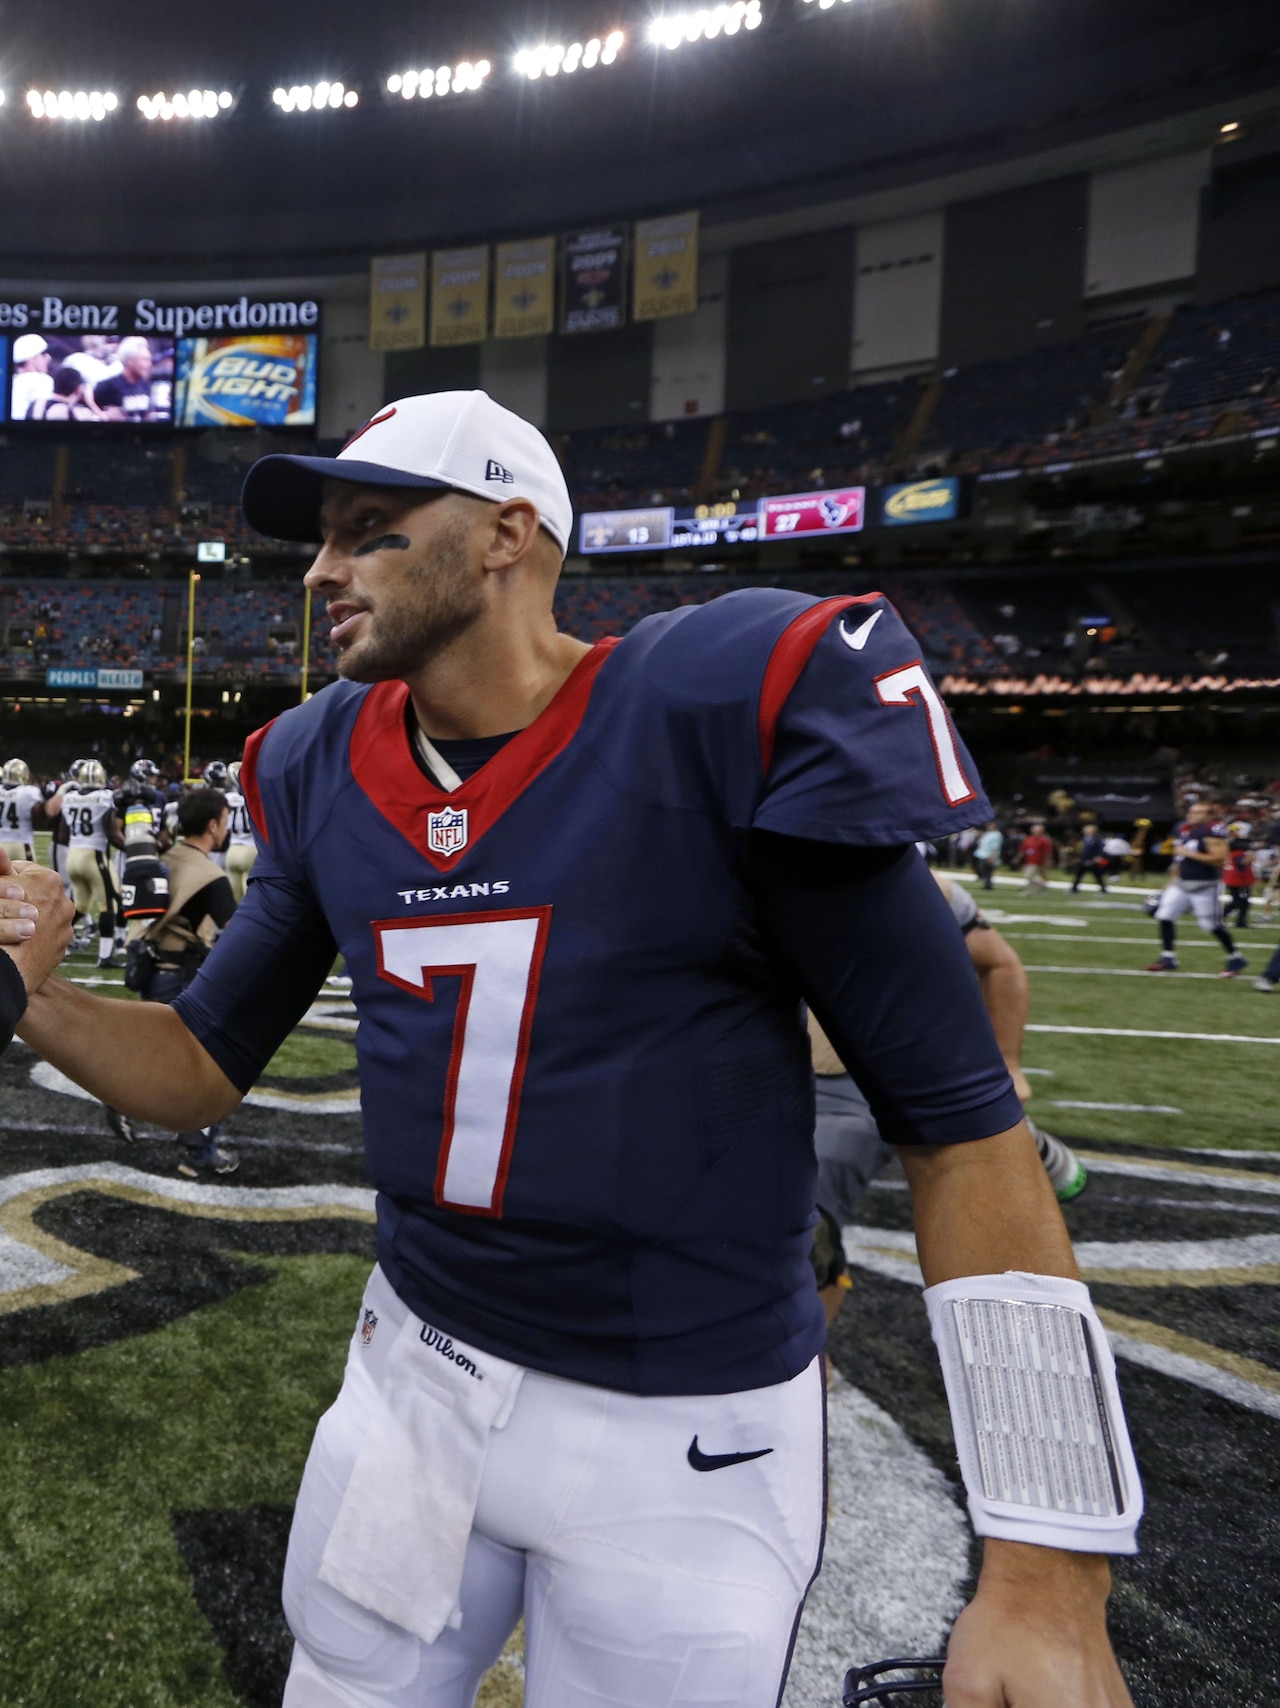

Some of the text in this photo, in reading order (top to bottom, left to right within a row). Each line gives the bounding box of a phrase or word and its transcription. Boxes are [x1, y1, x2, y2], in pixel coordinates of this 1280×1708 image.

[134, 296, 319, 337] Superdome
[565, 307, 619, 333] SAINTS
[211, 356, 298, 385] BUD
[195, 375, 299, 402] LIGHT
[694, 502, 737, 519] 0:00
[774, 513, 802, 532] 27
[48, 669, 96, 685] PEOPLES
[873, 658, 978, 809] 7
[69, 807, 94, 837] 78
[435, 828, 461, 847] NFL
[397, 880, 510, 904] TEXANS
[370, 904, 553, 1219] 7
[420, 1324, 477, 1377] Wilson
